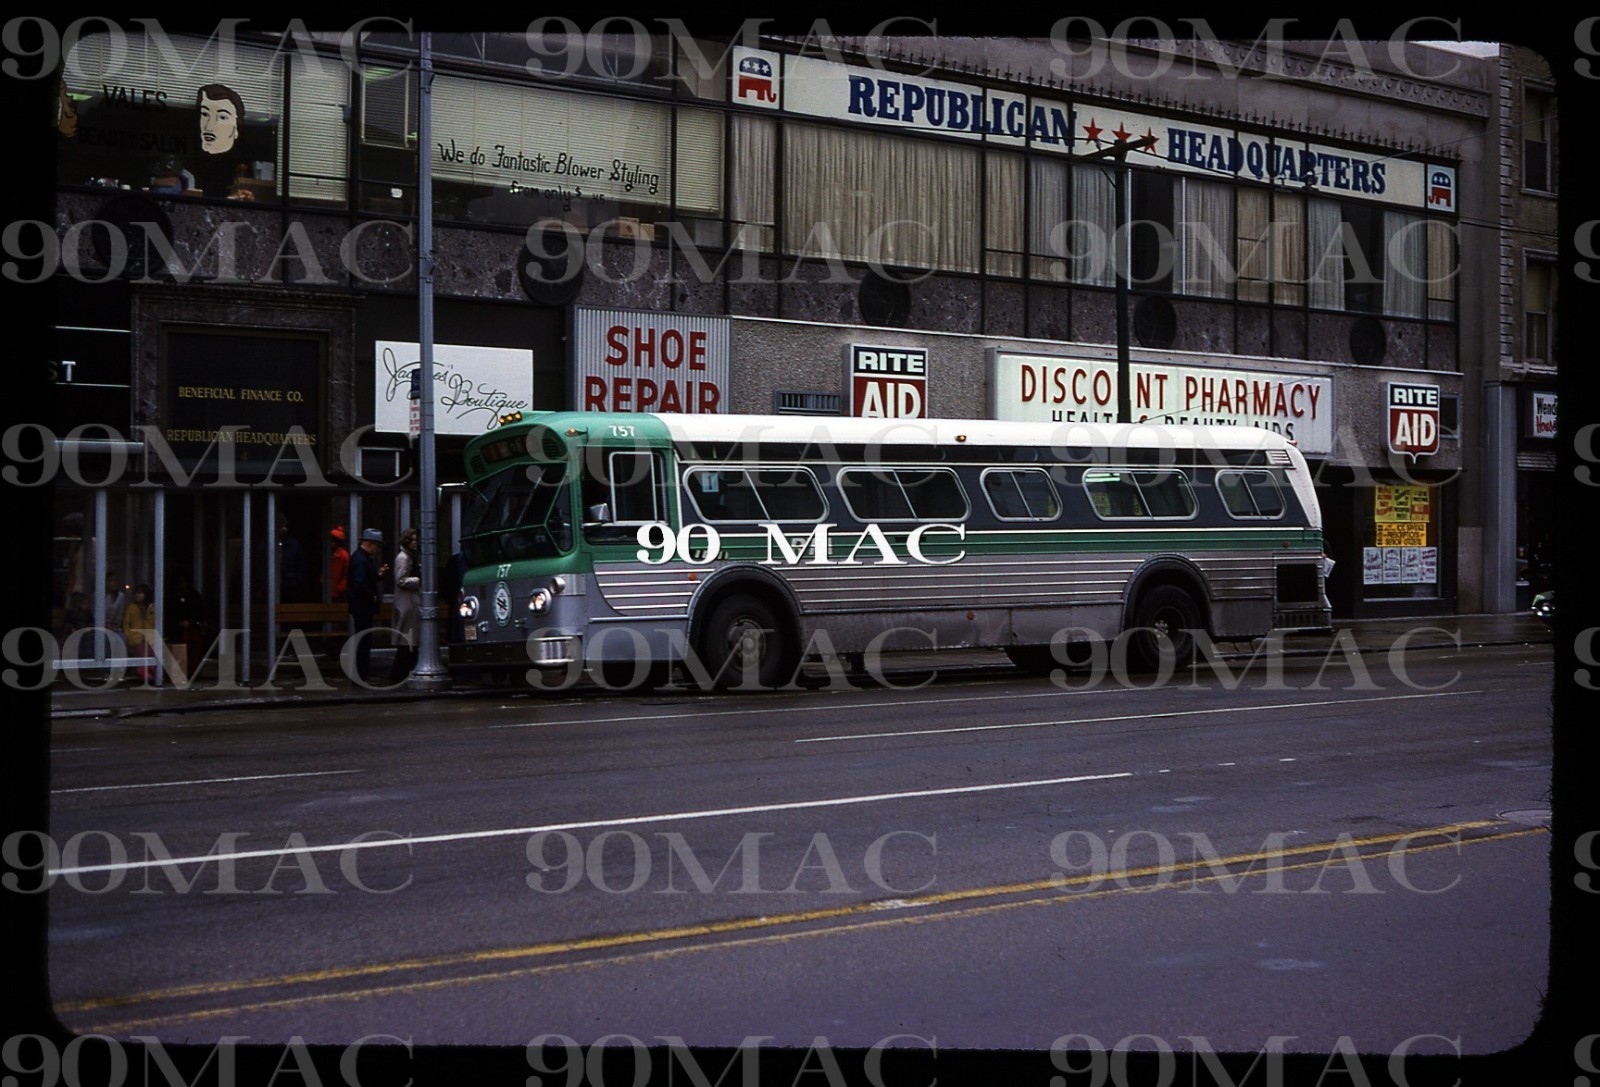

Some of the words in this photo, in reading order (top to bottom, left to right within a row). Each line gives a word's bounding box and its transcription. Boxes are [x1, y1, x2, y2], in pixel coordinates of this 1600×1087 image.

[103, 85, 167, 111] VALES
[848, 75, 1077, 147] REPUBLICAN
[1167, 128, 1386, 194] HEADQUARTERS
[437, 139, 464, 163] We
[470, 146, 485, 165] do
[492, 145, 550, 173] Fantastic
[554, 152, 604, 179] Blower
[608, 159, 659, 195] Styling
[605, 325, 707, 371] SHOE
[859, 351, 924, 373] RITE
[178, 386, 236, 399] BENEFICIAL
[241, 388, 282, 401] FINANCE
[286, 390, 304, 402] CO.
[441, 374, 528, 430] Boutique
[585, 375, 720, 413] REPAIR
[861, 381, 921, 418] AID
[1021, 365, 1168, 409] DISCONT
[1185, 376, 1321, 420] PHARMACY
[1394, 388, 1437, 405] RITE
[167, 429, 234, 443] REPUBLICAN
[235, 431, 317, 446] HEADQUARTERS
[609, 425, 635, 437] 757
[1395, 412, 1436, 446] AID
